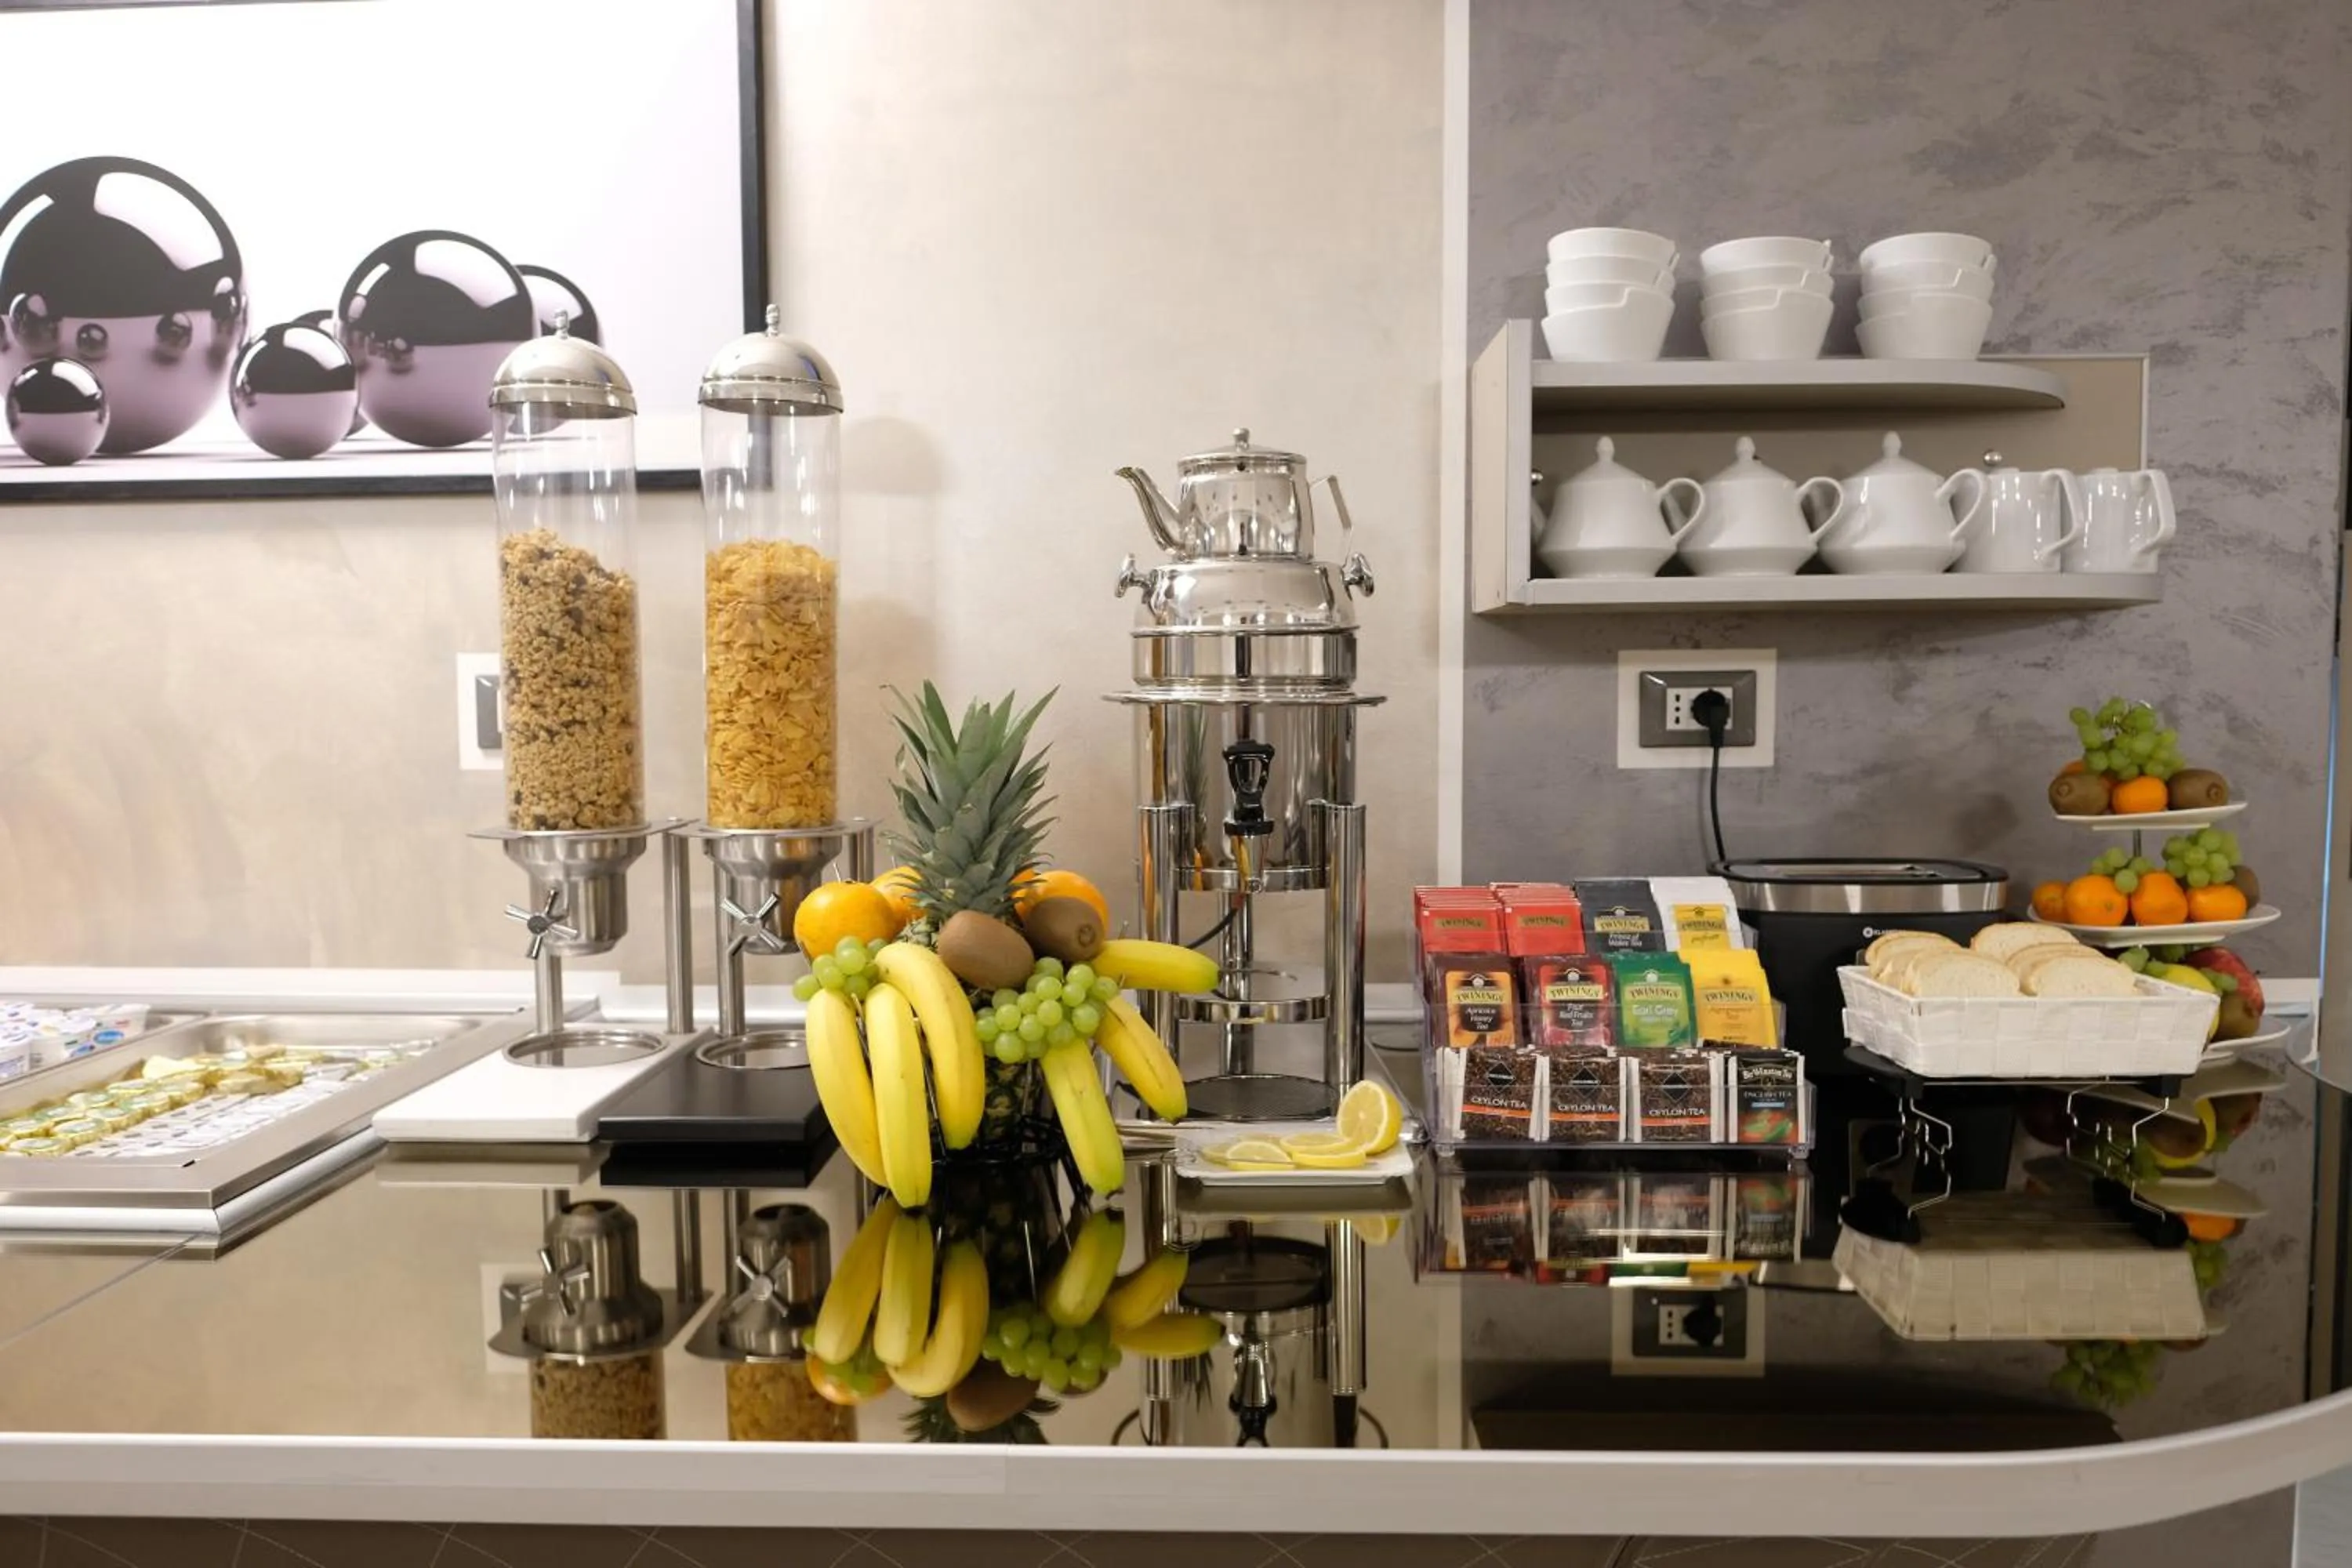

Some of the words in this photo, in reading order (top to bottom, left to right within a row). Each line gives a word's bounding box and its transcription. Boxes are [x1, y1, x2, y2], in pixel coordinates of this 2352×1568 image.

[1600, 918, 1646, 931] TWININGS
[1682, 919, 1722, 931] TWININGS
[1456, 990, 1504, 1002] TWININGS
[1549, 985, 1600, 998] TWININGS
[1629, 986, 1680, 999] TWININGS
[1704, 990, 1754, 1003] TWININGS
[1632, 1004, 1653, 1016] Earl
[1654, 1004, 1679, 1017] Grey
[1470, 1095, 1508, 1107] CEYLON
[1510, 1099, 1527, 1109] TEA
[1649, 1108, 1686, 1116] CEYLON
